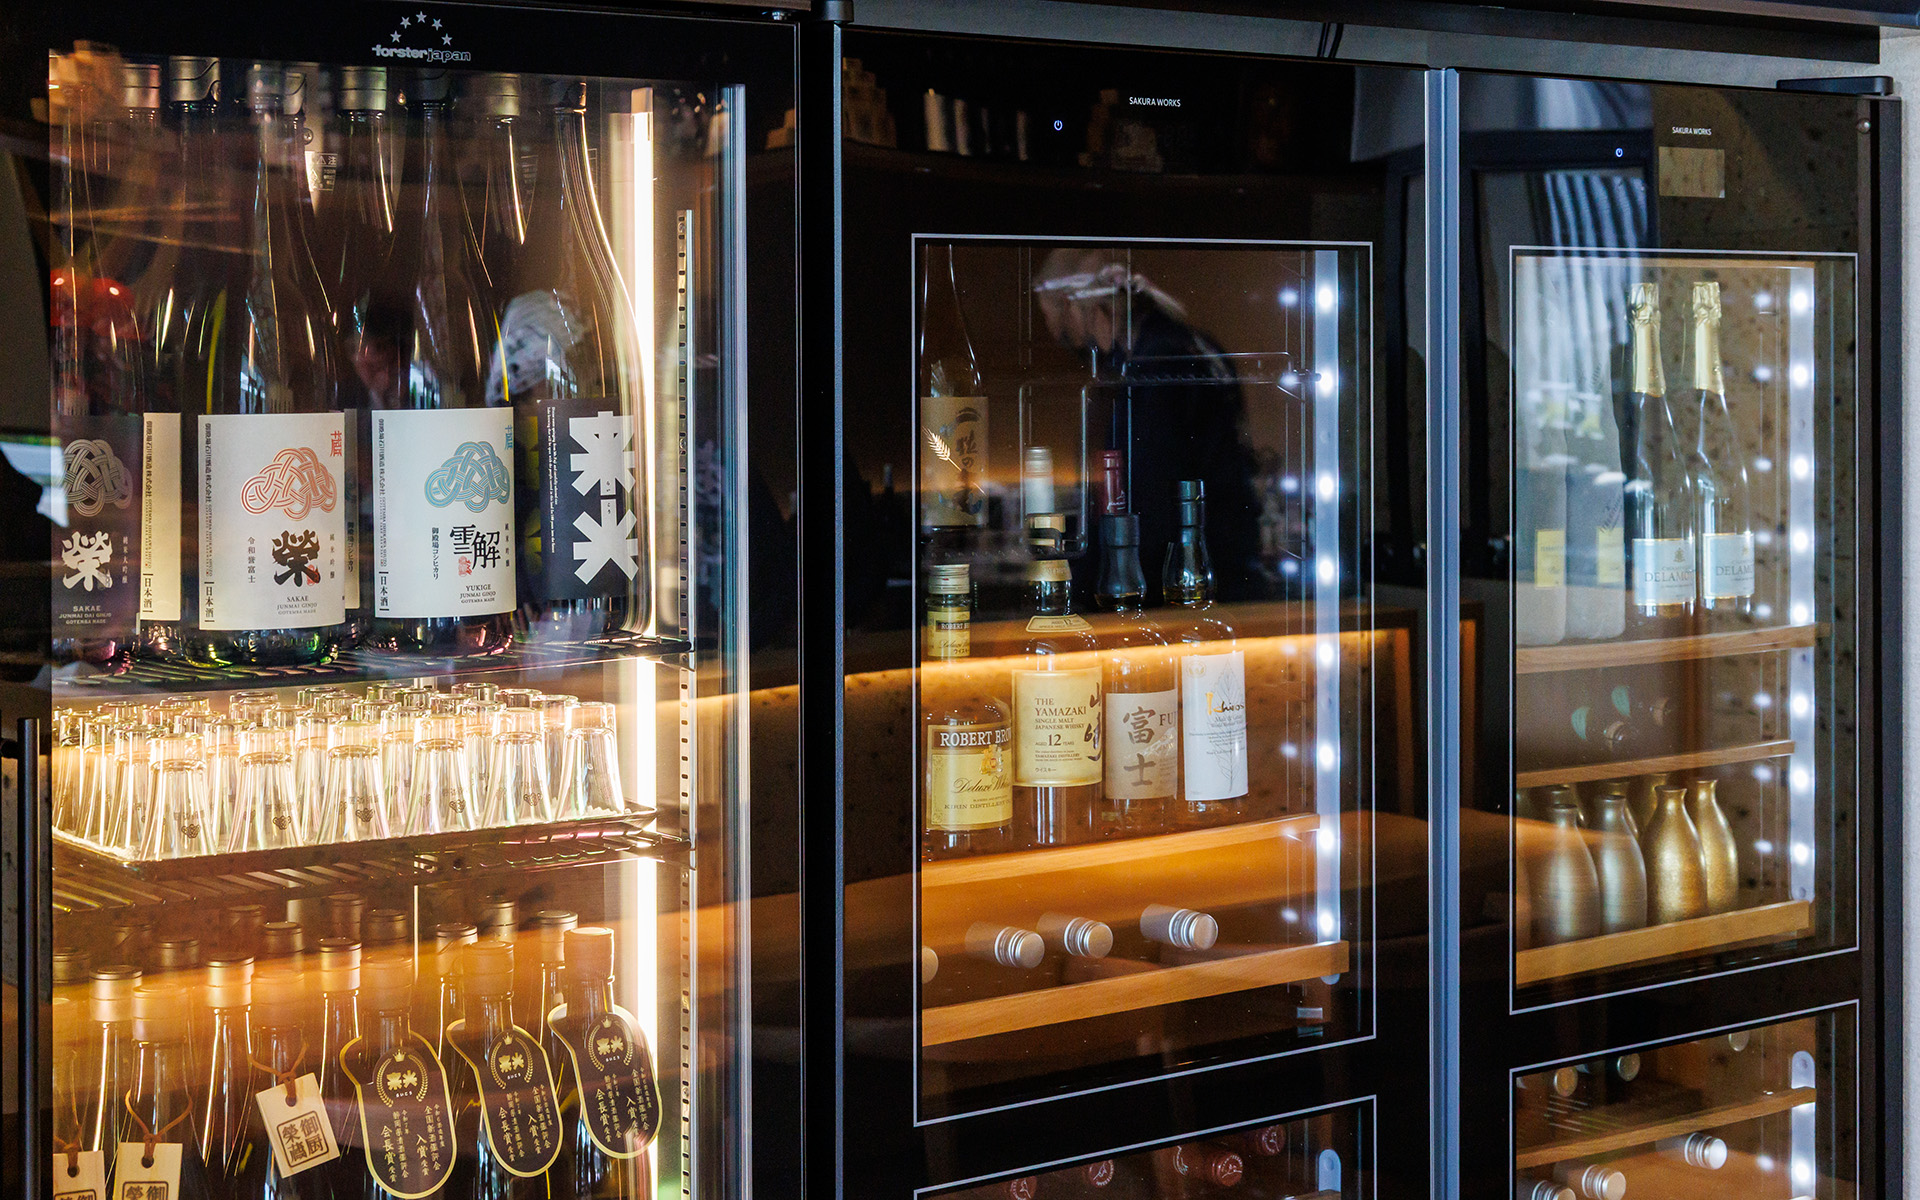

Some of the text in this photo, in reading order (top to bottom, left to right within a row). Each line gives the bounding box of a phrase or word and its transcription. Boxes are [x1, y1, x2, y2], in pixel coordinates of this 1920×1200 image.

[1129, 96, 1181, 107] SAKURA WORKS
[450, 524, 501, 570] 雪解
[248, 536, 256, 583] 令和誉富士
[144, 578, 152, 608] 日本酒
[205, 586, 214, 618] 日本酒
[1035, 698, 1054, 706] THE
[1035, 706, 1086, 716] YAMAZAKI
[940, 731, 992, 747] ROBERT
[1048, 734, 1061, 746] 12
[1123, 706, 1156, 786] 富士
[951, 778, 991, 794] Deluxe
[970, 801, 1005, 809] DISTILLERY
